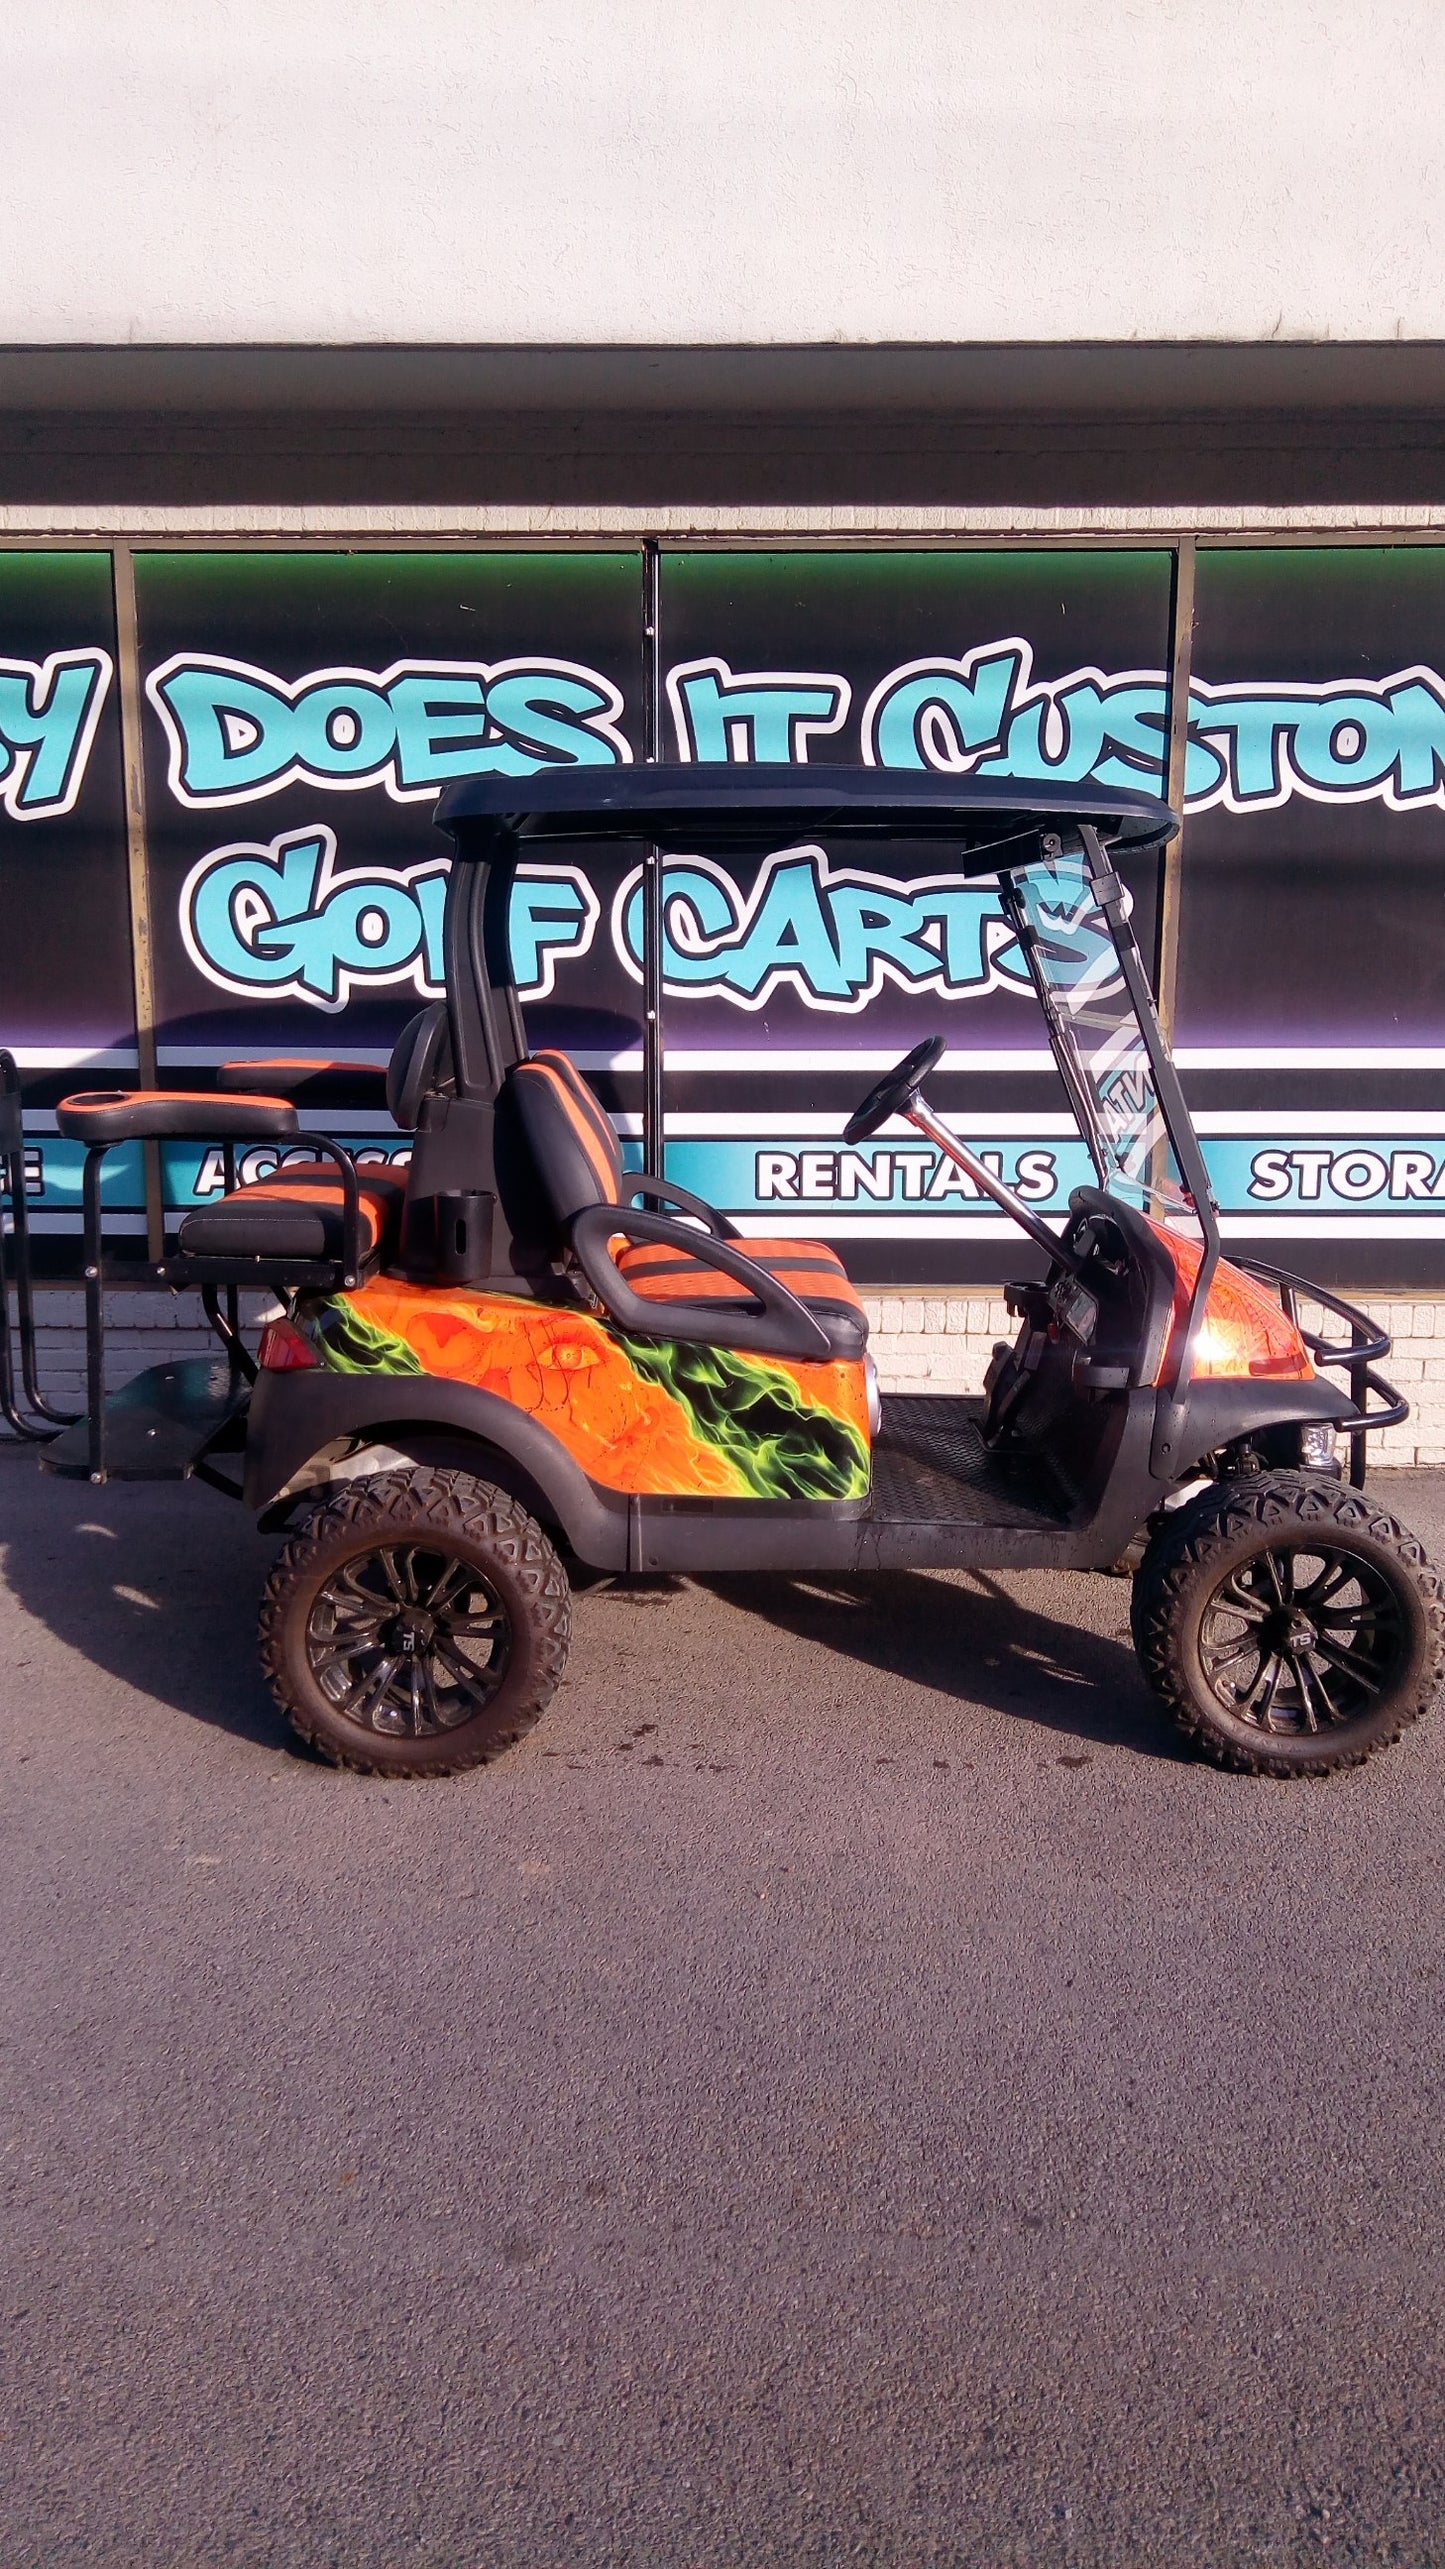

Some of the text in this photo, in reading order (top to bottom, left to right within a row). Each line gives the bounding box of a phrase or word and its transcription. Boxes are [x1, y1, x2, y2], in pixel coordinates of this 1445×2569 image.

[0, 647, 113, 821] Y
[146, 653, 633, 808] DOES
[668, 657, 852, 763] IT
[612, 845, 1133, 1013] CARTS
[756, 1151, 1057, 1202] RENTALS
[1247, 1149, 1445, 1201] STOR
